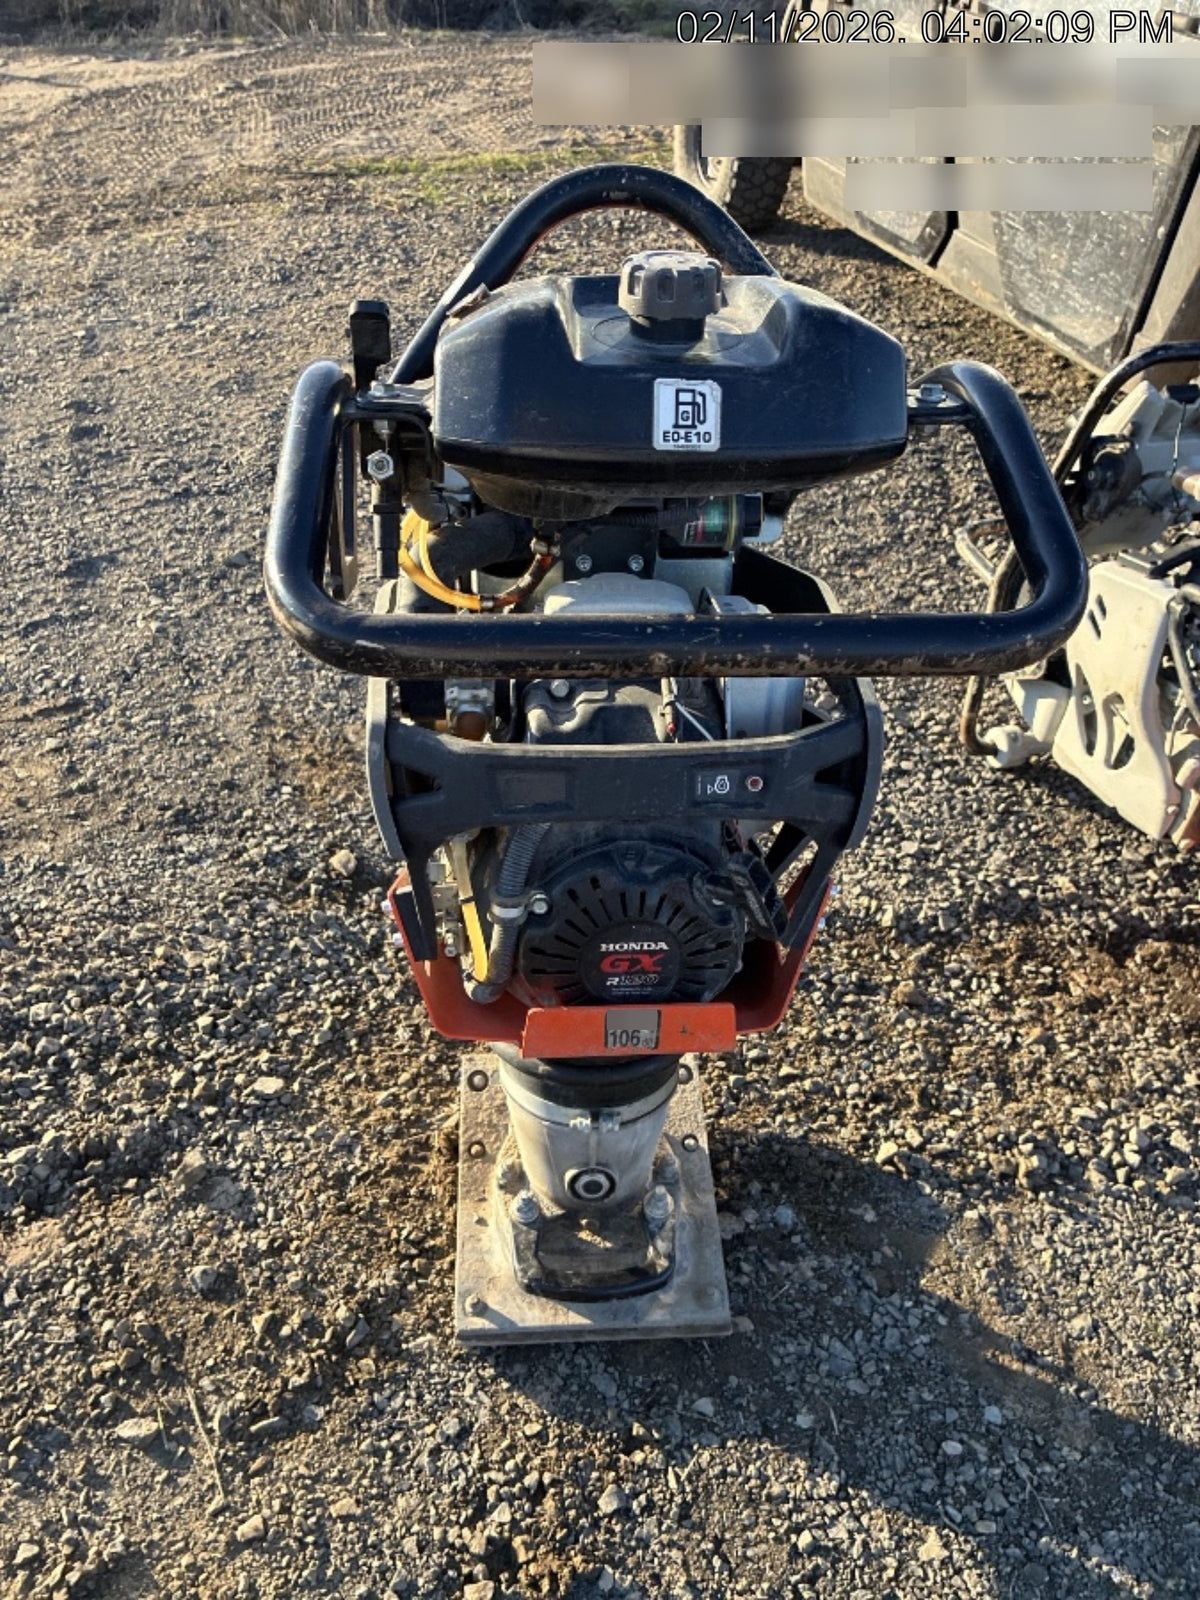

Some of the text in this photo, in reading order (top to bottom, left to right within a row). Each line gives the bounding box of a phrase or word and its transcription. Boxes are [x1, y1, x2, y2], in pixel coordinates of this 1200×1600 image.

[600, 942, 669, 952] HONDA
[600, 953, 667, 973] GX
[609, 1029, 640, 1048] 106
